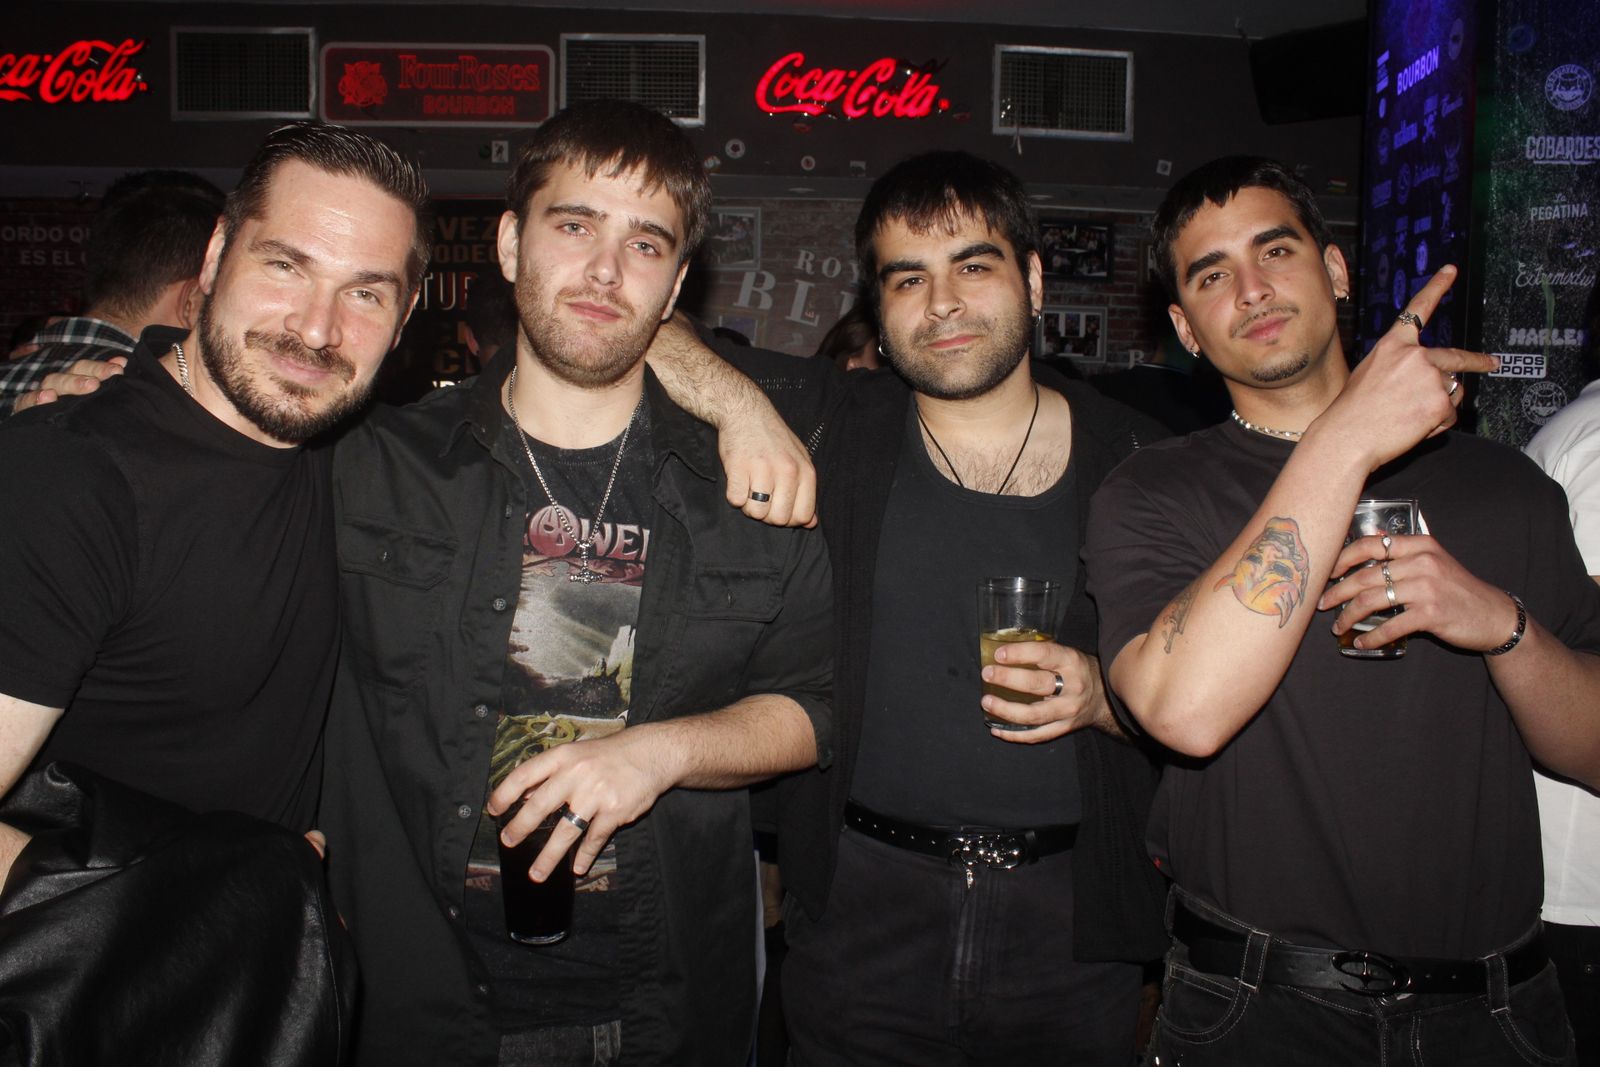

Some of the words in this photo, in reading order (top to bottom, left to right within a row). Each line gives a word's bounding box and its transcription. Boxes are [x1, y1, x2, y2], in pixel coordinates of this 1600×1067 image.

[1397, 45, 1439, 95] BOURBON
[755, 52, 943, 118] Coca-Cola
[423, 96, 516, 115] BOURBON
[1530, 204, 1588, 220] PEGATINA
[1, 226, 63, 242] ORDO
[433, 215, 497, 241] VEZ
[20, 250, 47, 265] ES
[52, 250, 76, 265] EL
[1499, 355, 1545, 365] UFOS
